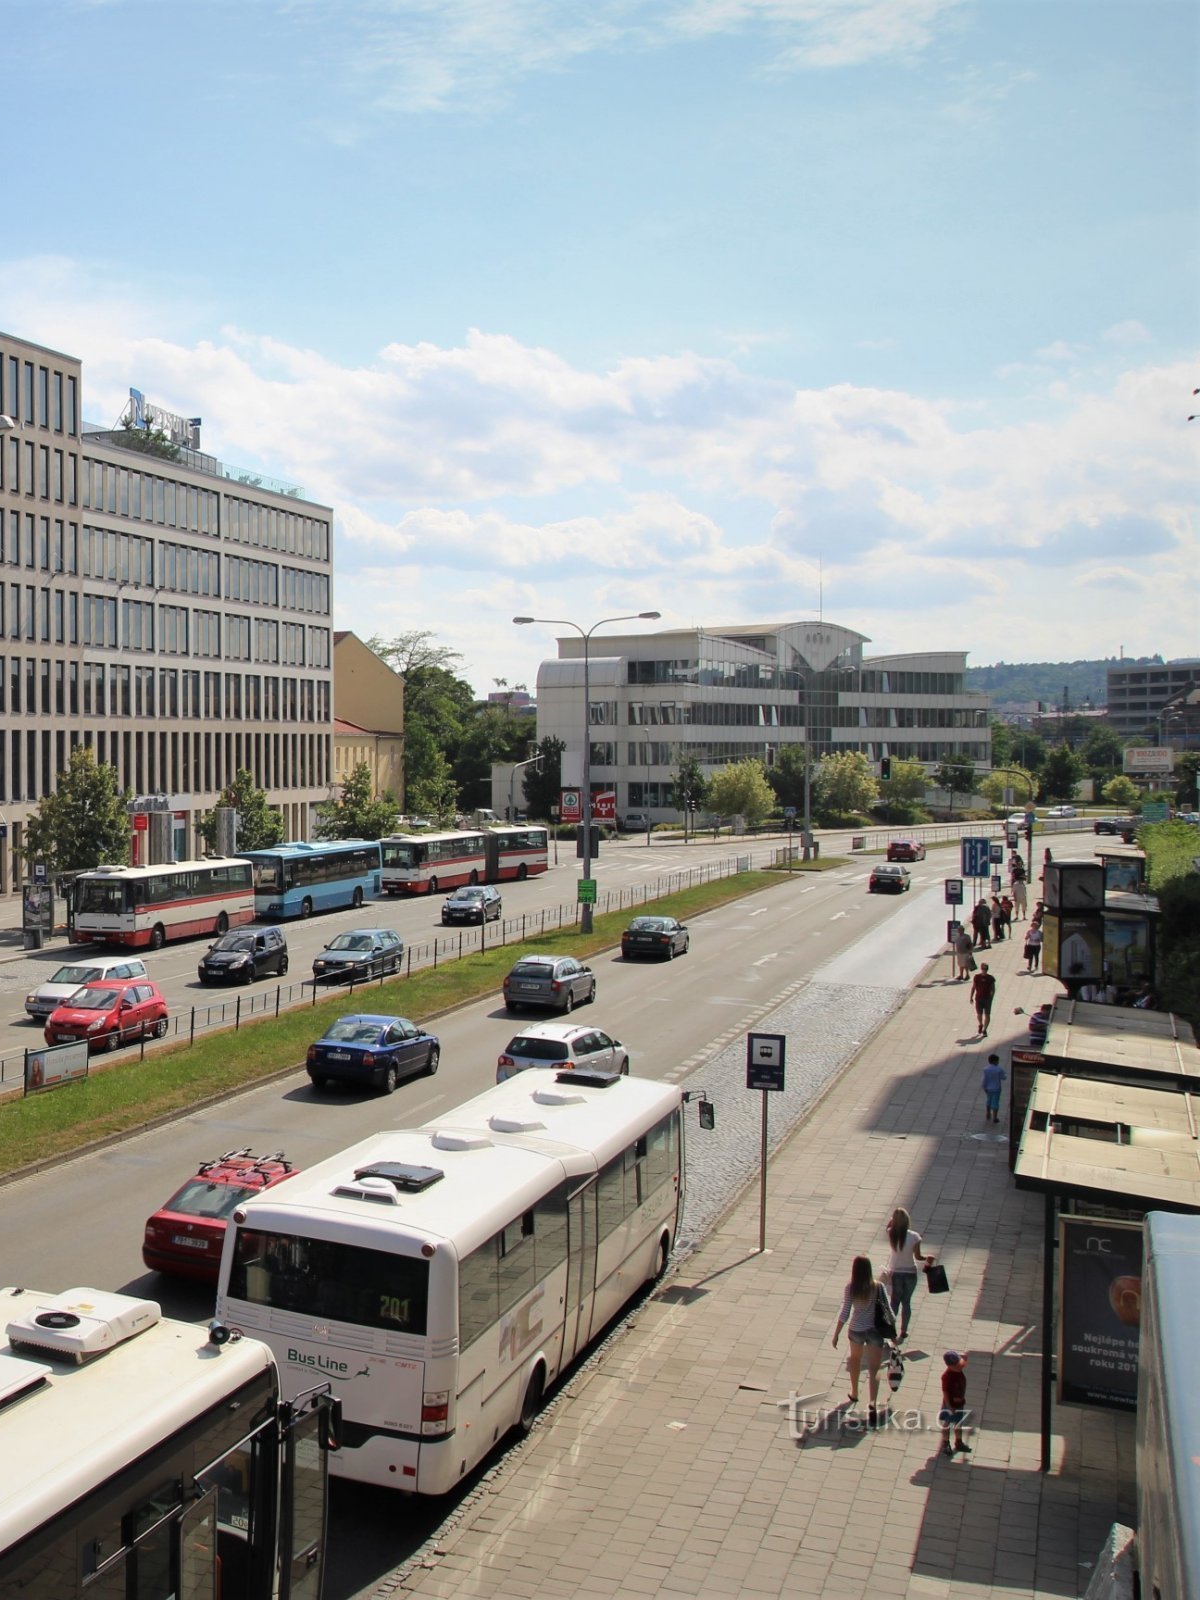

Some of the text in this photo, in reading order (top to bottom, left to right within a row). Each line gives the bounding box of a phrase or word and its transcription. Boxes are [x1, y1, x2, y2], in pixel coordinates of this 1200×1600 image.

[380, 1295, 411, 1322] 201
[1083, 1332, 1126, 1347] Nejlépe
[1072, 1344, 1126, 1359] soukromá
[1089, 1359, 1115, 1369] roku
